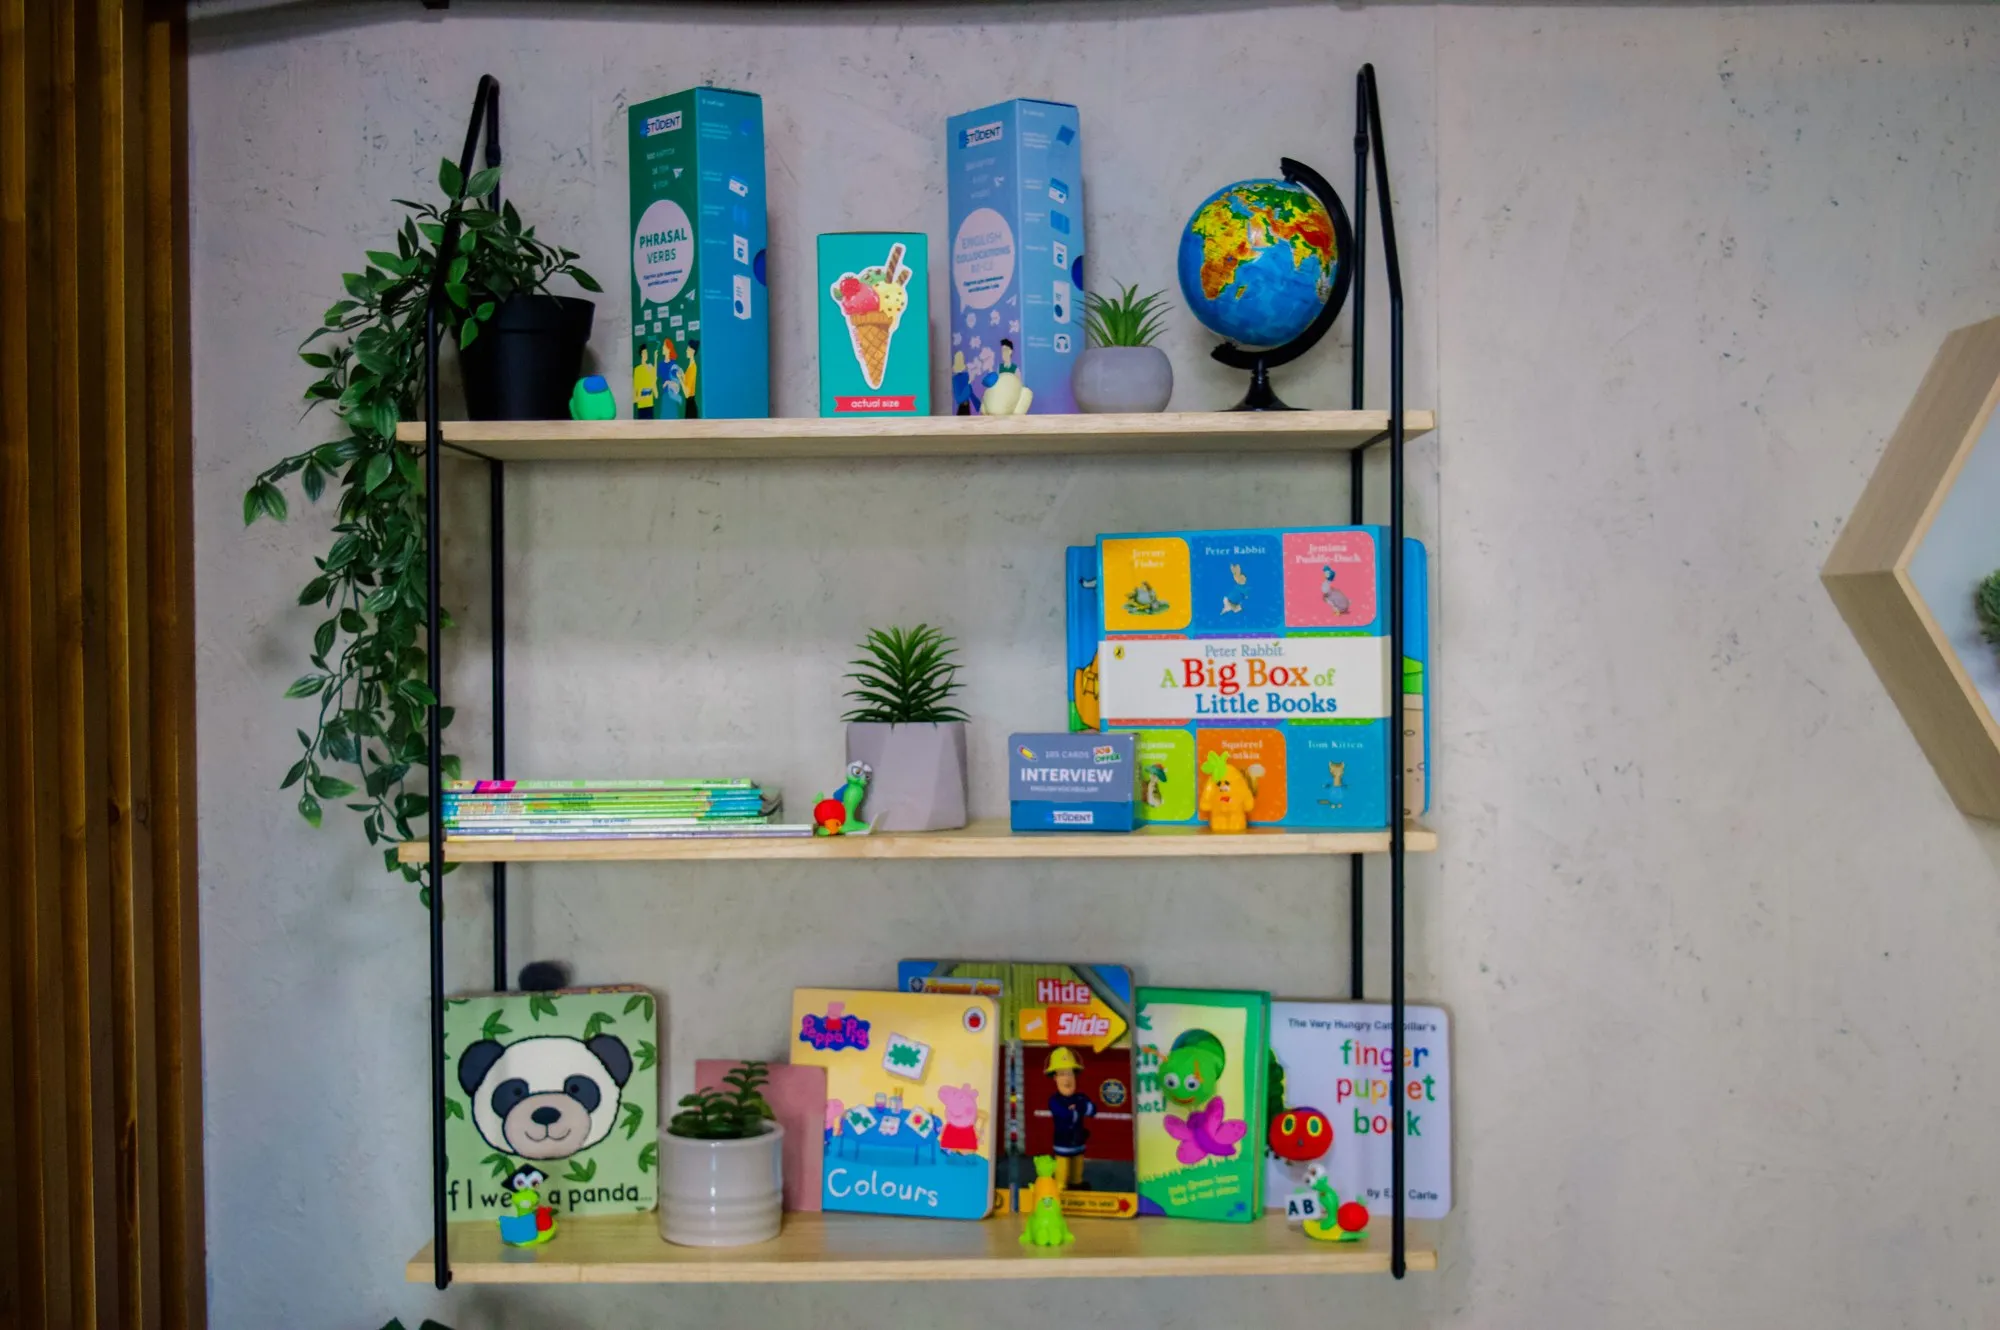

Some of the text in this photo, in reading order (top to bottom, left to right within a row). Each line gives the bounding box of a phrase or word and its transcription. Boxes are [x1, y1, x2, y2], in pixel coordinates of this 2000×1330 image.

[639, 227, 688, 249] PHRASAL
[961, 231, 1003, 250] ENGLISH
[646, 248, 677, 265] VERBS
[851, 398, 900, 409] actual size
[1205, 545, 1266, 556] Peter Rabbit
[1295, 553, 1362, 564] Puddle-Duck
[1205, 643, 1284, 657] Peter Rabbit
[1160, 658, 1336, 695] A Big Box of
[1195, 691, 1338, 714] Little Books
[1221, 740, 1263, 750] Squirrel
[1308, 740, 1328, 749] Tom
[1061, 750, 1090, 760] CARDS
[1021, 768, 1114, 783] INTERVIEW
[1038, 979, 1090, 1003] Hide
[802, 1015, 868, 1048] Peppa Pig
[1057, 1012, 1109, 1036] Slide
[1288, 1018, 1307, 1029] The
[1310, 1019, 1331, 1031] Very
[1334, 1020, 1371, 1033] Hungry
[1336, 1074, 1436, 1107] pupet
[1354, 1108, 1422, 1137] bok
[827, 1167, 938, 1208] Colours
[1408, 1189, 1438, 1200] Carle
[548, 1189, 561, 1205] a
